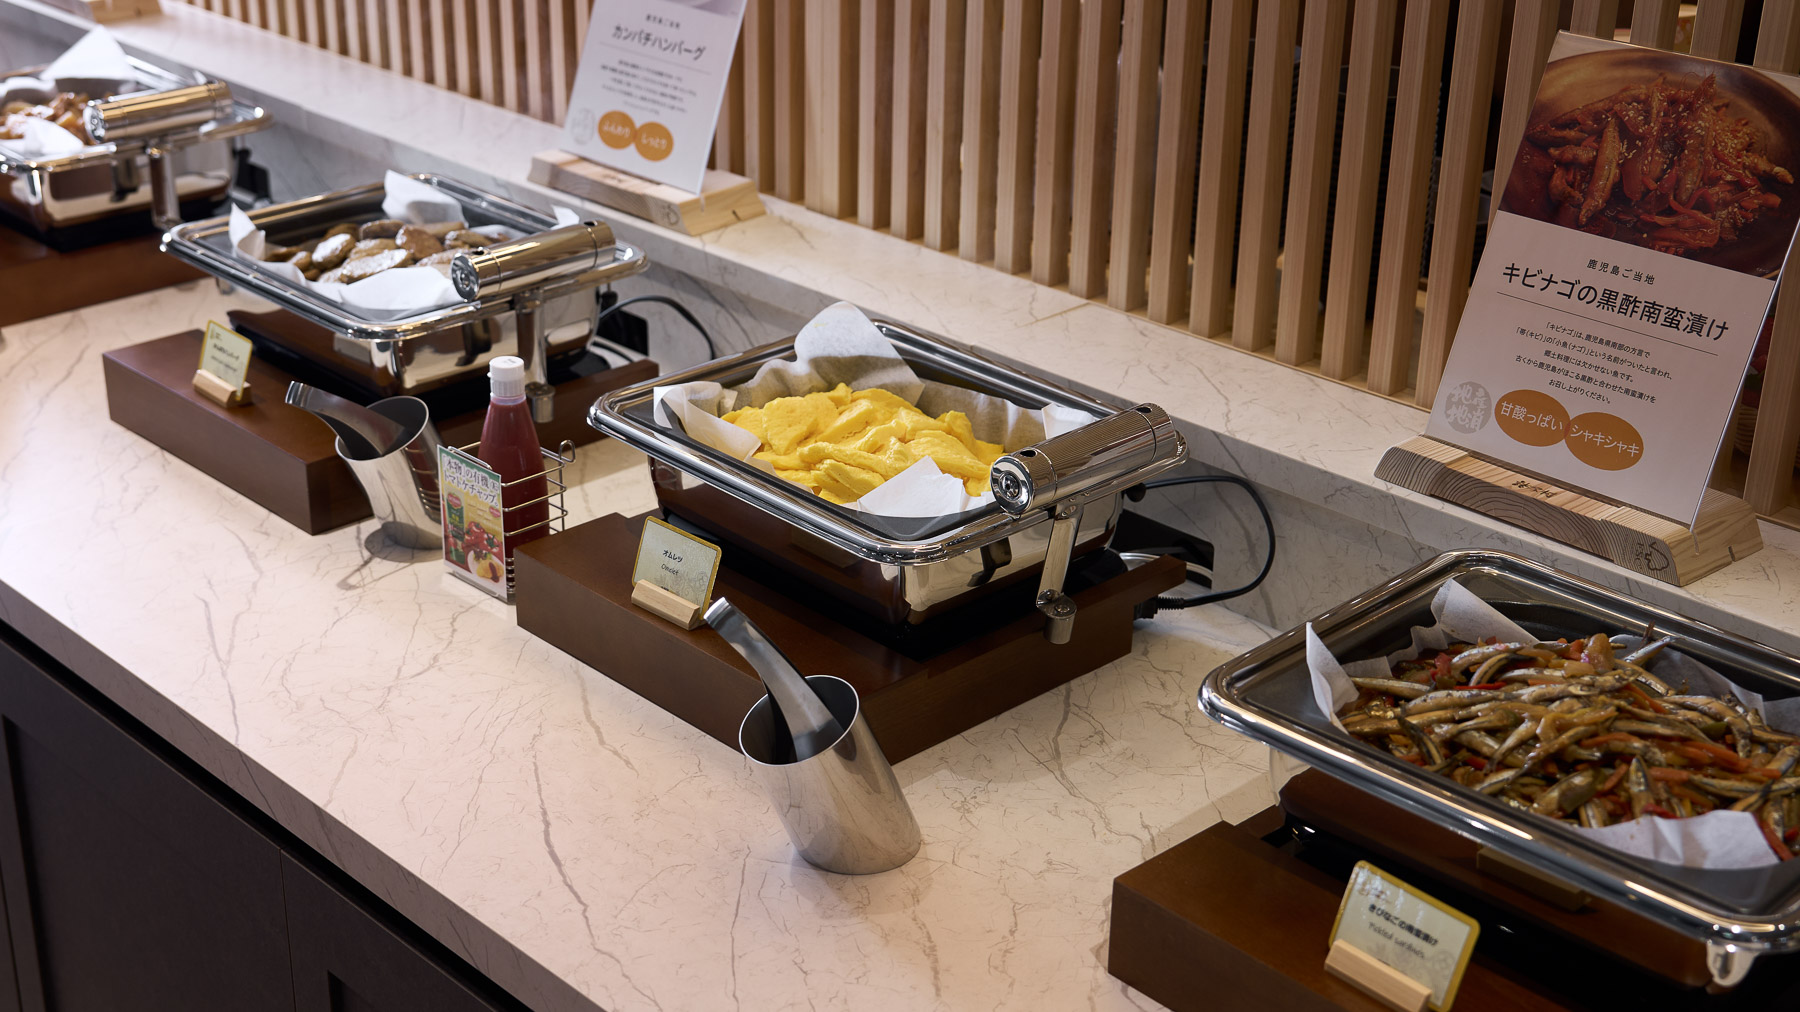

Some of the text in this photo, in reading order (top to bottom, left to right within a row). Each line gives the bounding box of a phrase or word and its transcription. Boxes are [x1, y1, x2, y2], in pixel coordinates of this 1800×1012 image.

[612, 24, 706, 61] カンパチハンバーグ
[1587, 259, 1656, 286] 鹿児島ご当地
[1502, 263, 1729, 342] キビナゴの黒酢南蛮漬け
[1548, 379, 1611, 404] お召し上がりください。
[1501, 401, 1563, 431] 甘酸っぱい
[1570, 424, 1640, 457] シャキシャキ
[662, 549, 683, 563] オムレツ
